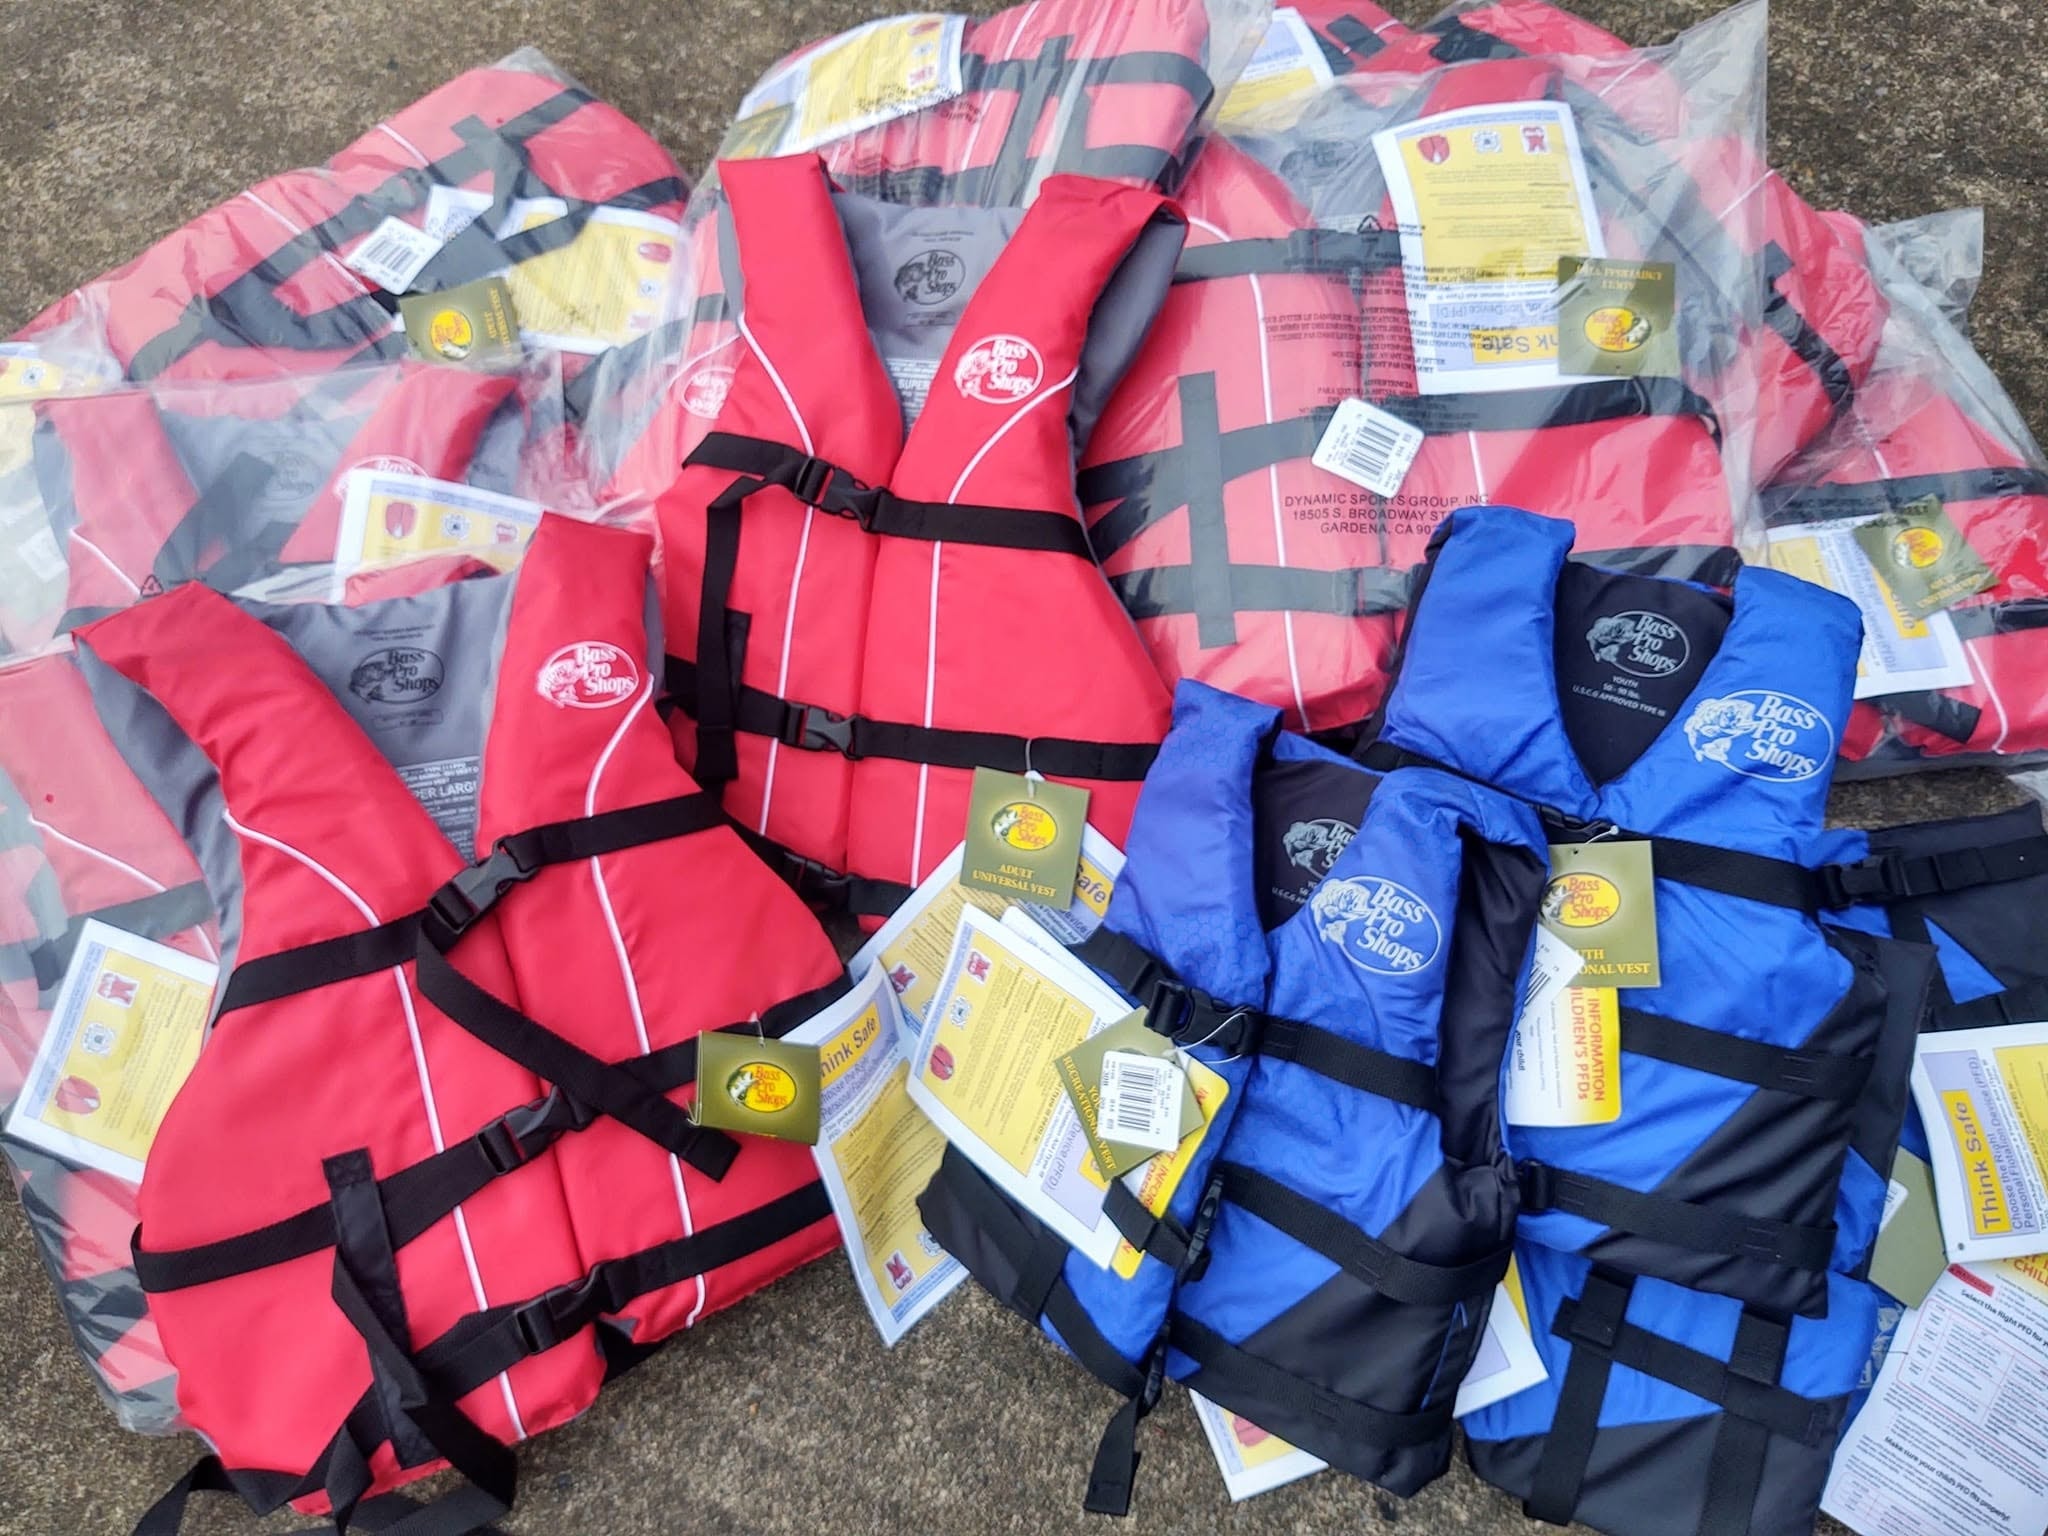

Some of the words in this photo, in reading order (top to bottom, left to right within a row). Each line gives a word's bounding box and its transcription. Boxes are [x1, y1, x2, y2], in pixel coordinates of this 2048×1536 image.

[991, 339, 1029, 360] Bass
[1480, 335, 1529, 353] Safe
[990, 358, 1018, 375] Pro
[986, 374, 1035, 397] Shops
[1284, 494, 1347, 508] DYNAMIC
[1350, 494, 1406, 508] SPORTS
[1293, 508, 1329, 521] 18505
[1332, 508, 1345, 519] S.
[1348, 509, 1427, 521] BROADWAY
[1320, 522, 1391, 535] GARDENA,
[1394, 523, 1415, 535] CA
[1636, 615, 1677, 640] Bass
[1632, 632, 1663, 651] Pro
[388, 650, 427, 664] Bass
[575, 644, 618, 663] Bass
[1627, 647, 1677, 671] Shops
[391, 664, 418, 680] Pro
[578, 660, 611, 678] Pro
[393, 675, 440, 694] Shops
[584, 674, 635, 697] Shops
[1612, 676, 1639, 688] YOUTH
[1599, 692, 1640, 710] APPROVED
[1640, 703, 1658, 715] TYPE
[1755, 695, 1819, 730] Bass
[1750, 718, 1797, 746] Pro
[1744, 739, 1818, 777] Shops
[972, 869, 1029, 891] UNIVERSAL
[1029, 883, 1057, 897] VEST
[998, 863, 1034, 880] ADULT
[1568, 877, 1600, 891] Bass
[1370, 883, 1426, 923] Bass
[1570, 891, 1594, 905] Pro
[1364, 906, 1404, 937] Pro
[1570, 904, 1610, 921] Shops
[1356, 926, 1423, 971] Shops
[1576, 949, 1604, 961] UTH
[1615, 961, 1651, 975] VEST
[1571, 987, 1587, 1058] ILDREN'S
[820, 1041, 852, 1079] hink
[851, 1017, 877, 1049] Safe
[1588, 998, 1605, 1101] INFORMATION
[755, 1065, 781, 1081] Bass
[1577, 1061, 1590, 1100] PFDs
[1967, 1055, 1986, 1088] (PFD)
[755, 1077, 775, 1093] Pro
[1955, 1101, 1982, 1153] Safe
[1098, 1140, 1117, 1170] VEST
[1998, 1129, 2018, 1177] Flotation
[1049, 1157, 1066, 1191] (PFD)
[1973, 1159, 2001, 1230] Think
[2015, 1177, 2034, 1228] Personal
[2006, 1183, 2023, 1230] Choose
[1961, 1290, 1984, 1306] Select
[1997, 1311, 2017, 1326] Right
[1884, 1436, 1903, 1451] Make
[1935, 1469, 1955, 1485] child's
[1980, 1499, 2009, 1521] properly!
